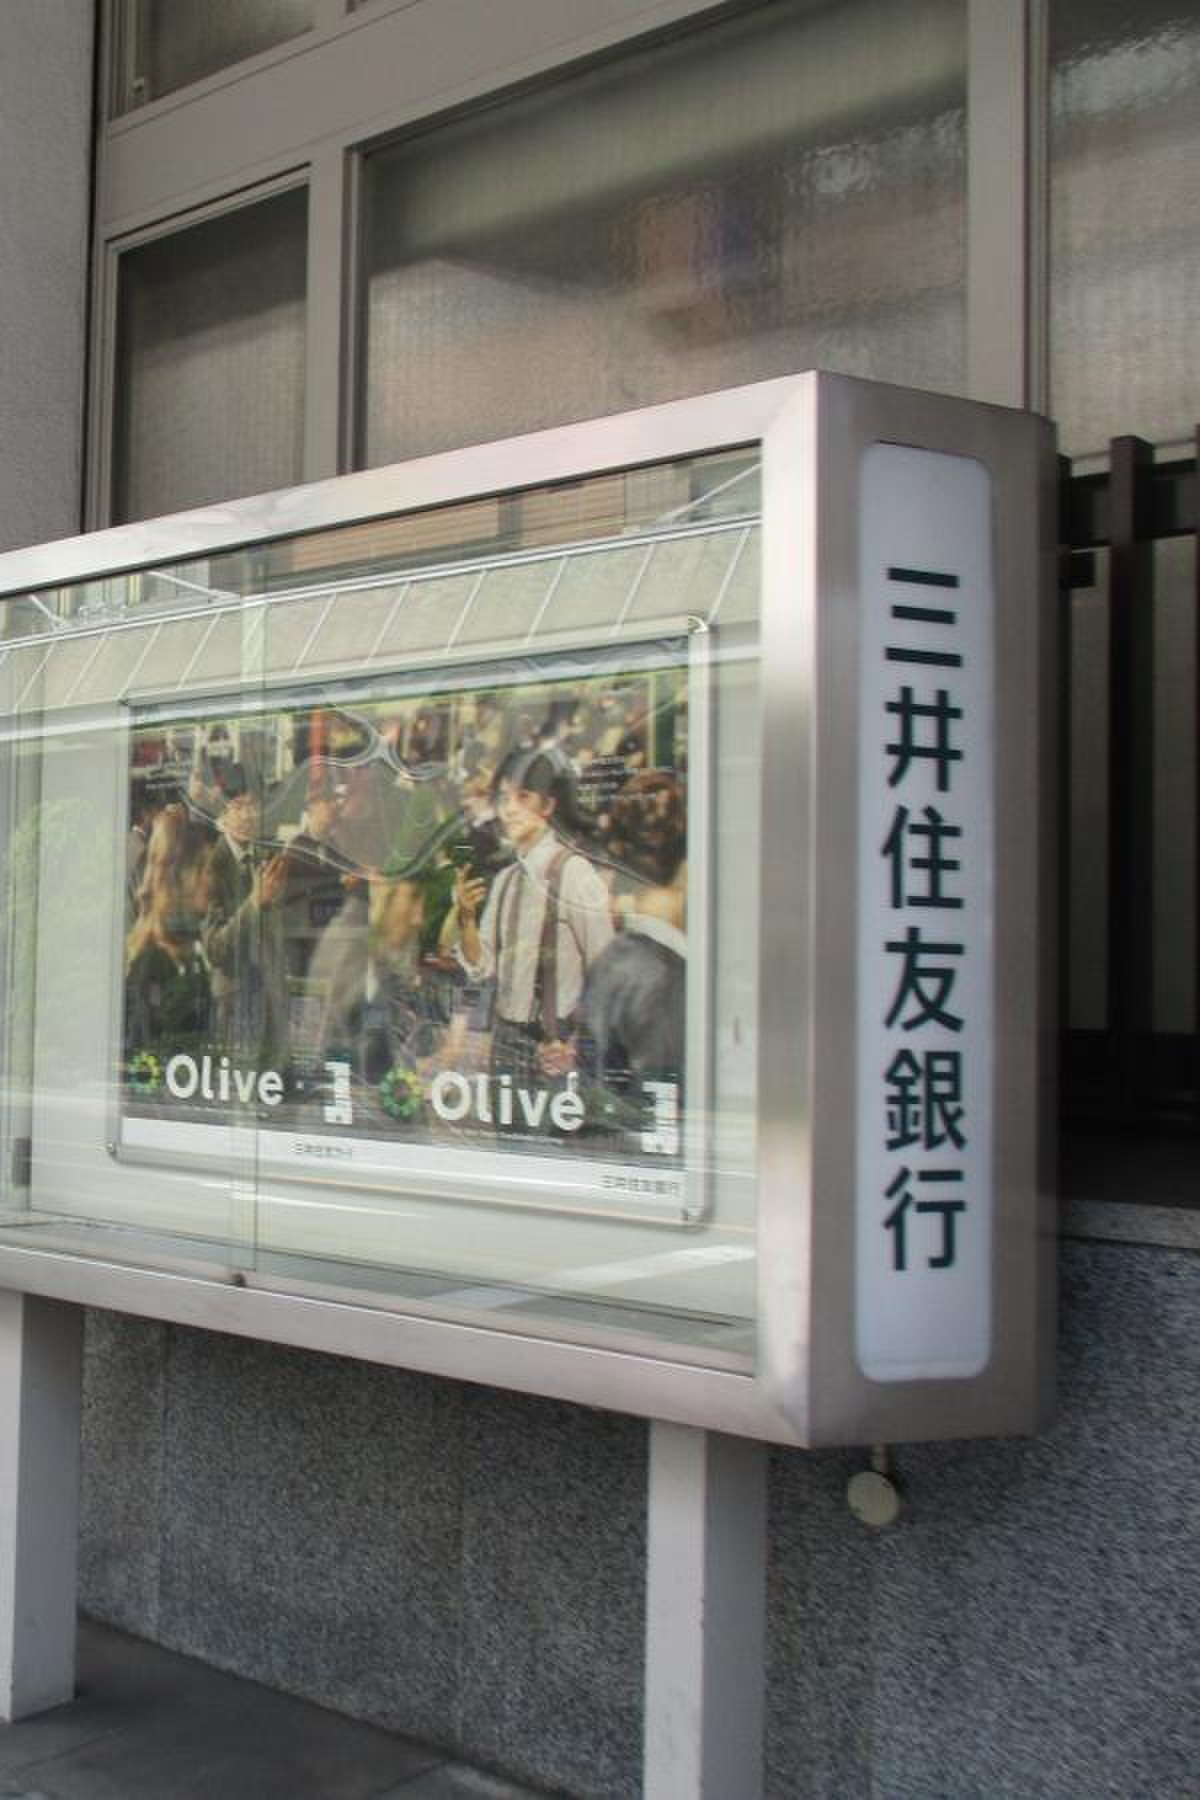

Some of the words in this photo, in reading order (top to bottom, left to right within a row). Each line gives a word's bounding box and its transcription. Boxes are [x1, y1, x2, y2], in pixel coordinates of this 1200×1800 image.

[881, 567, 966, 1271] 三井住友銀行
[166, 1054, 284, 1105] Olive
[432, 1071, 586, 1131] Olive
